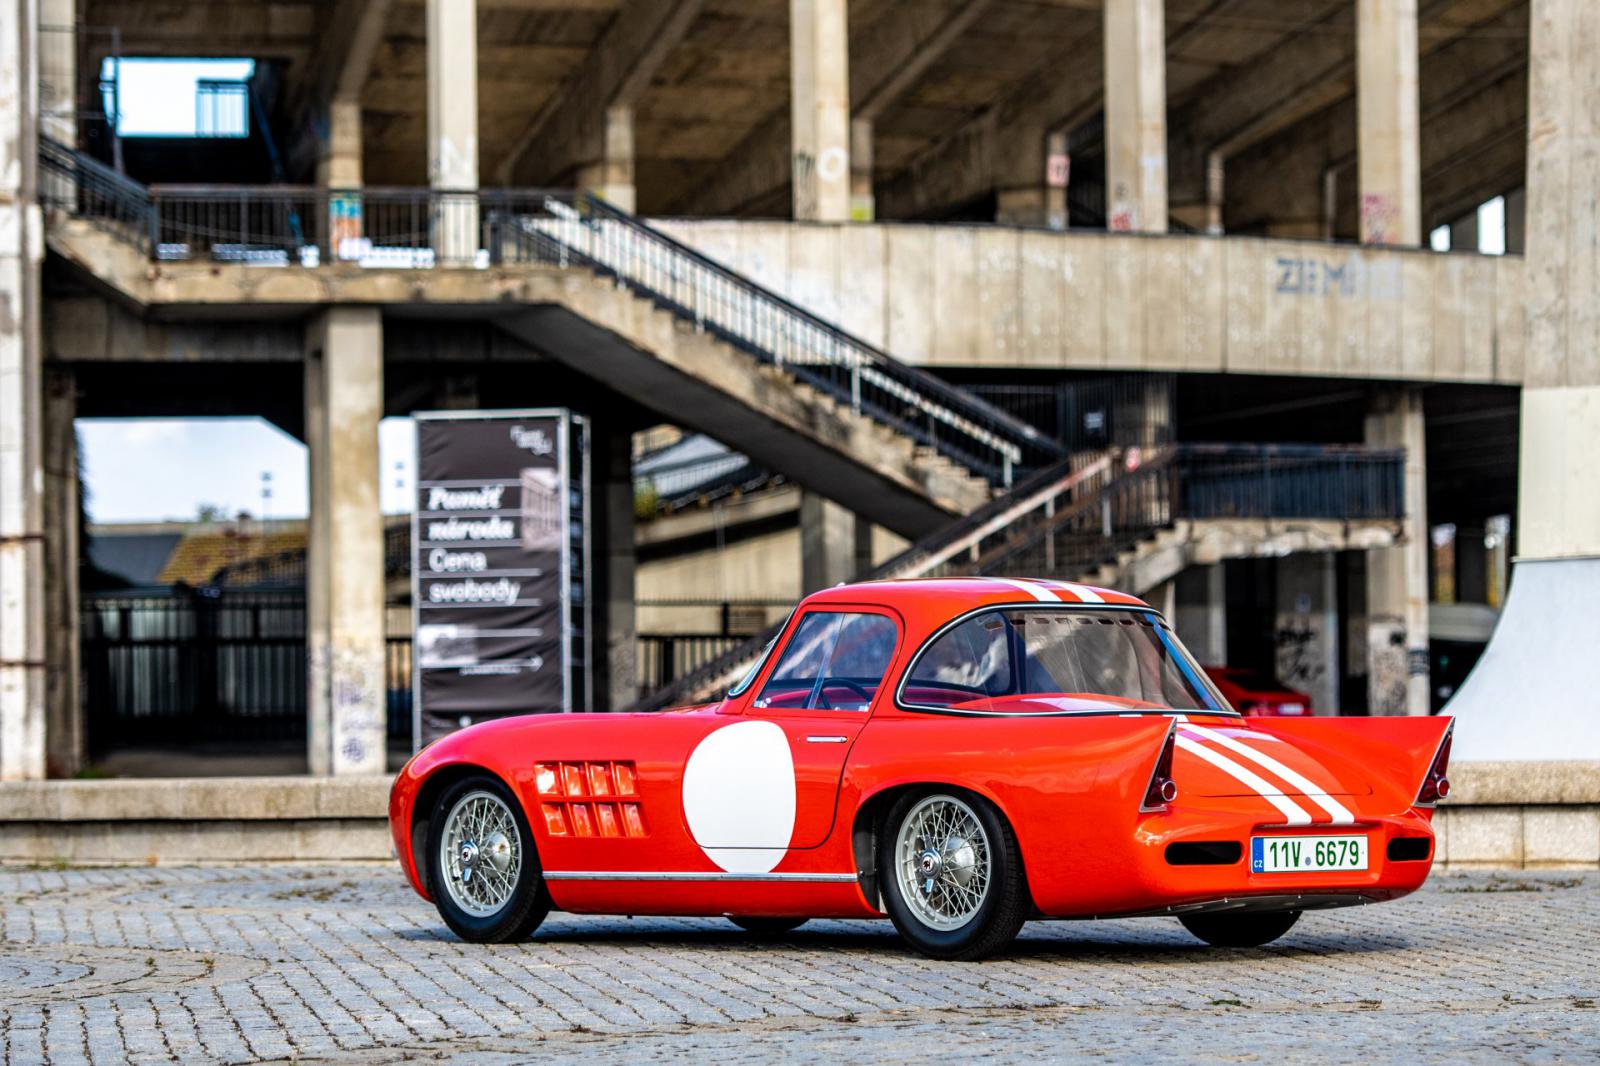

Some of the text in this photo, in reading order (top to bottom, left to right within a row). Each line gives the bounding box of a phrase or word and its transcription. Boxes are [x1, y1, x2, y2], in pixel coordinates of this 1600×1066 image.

[429, 516, 514, 539] národa
[429, 548, 487, 572] Cena
[429, 578, 520, 605] svobody
[1253, 860, 1263, 868] CZ
[1269, 840, 1359, 868] 11V 6679
